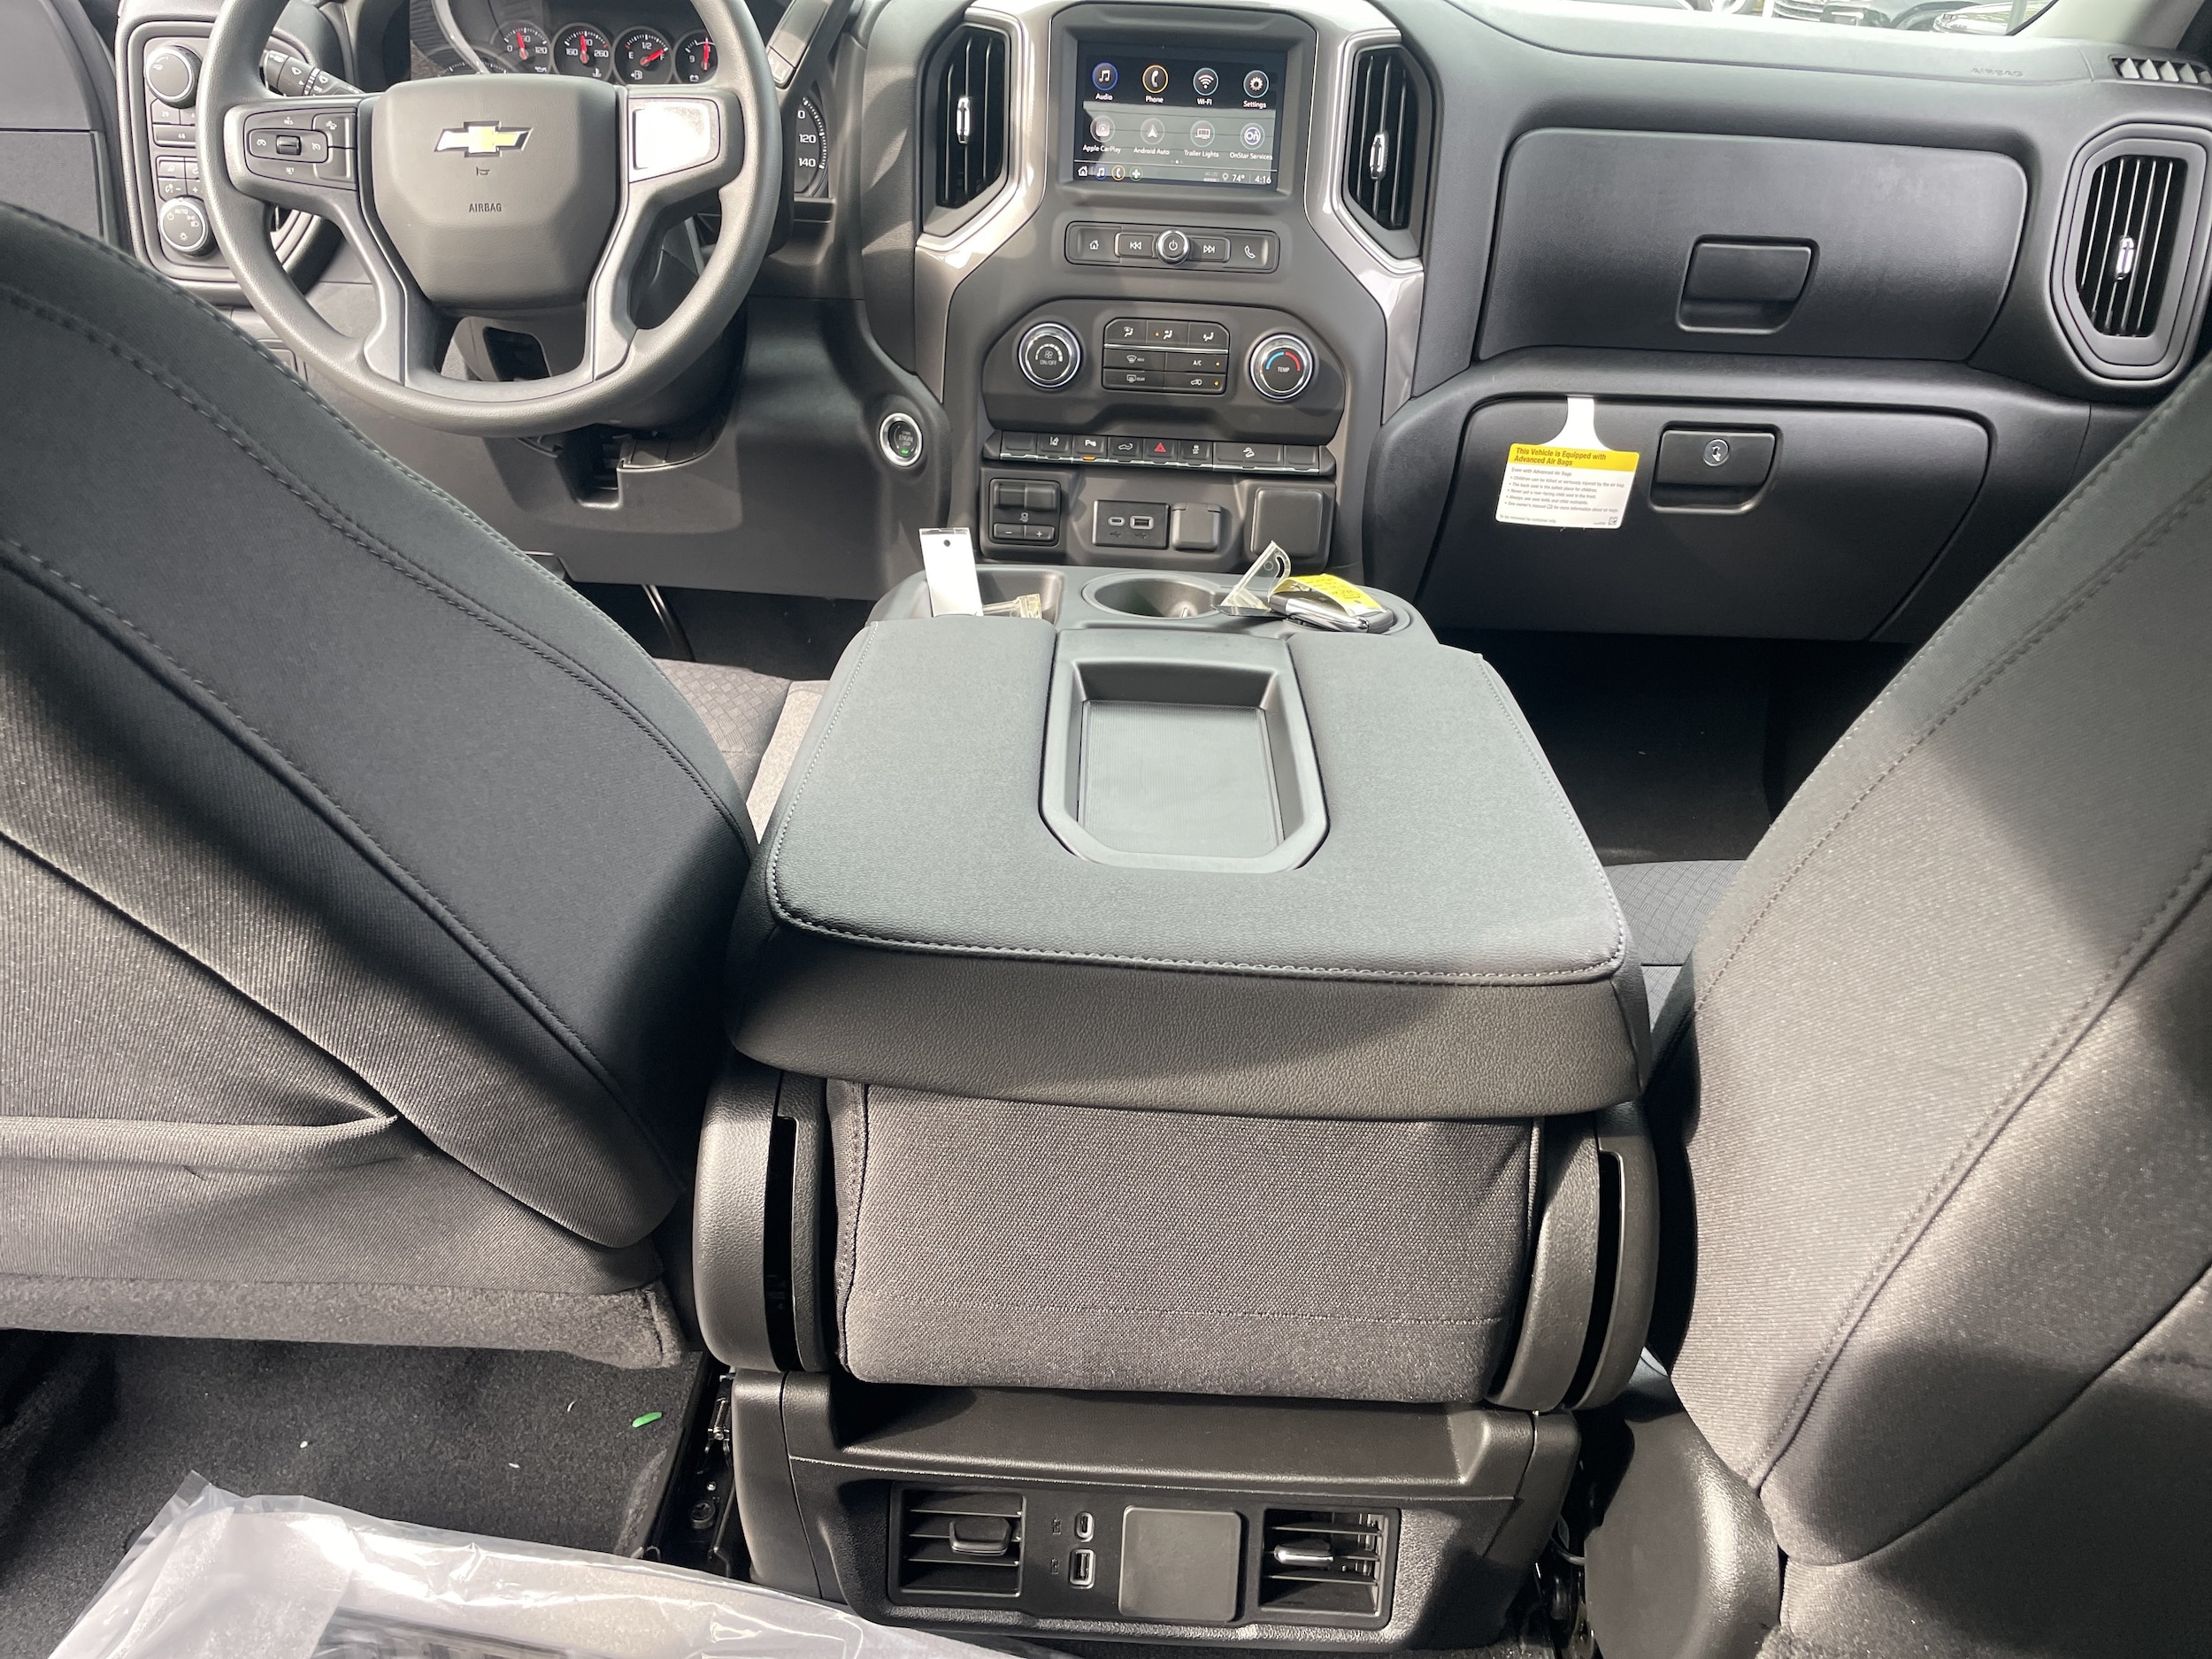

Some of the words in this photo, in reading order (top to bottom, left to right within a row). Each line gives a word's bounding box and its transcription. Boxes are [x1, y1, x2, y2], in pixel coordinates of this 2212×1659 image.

[535, 46, 548, 54] 120
[1243, 100, 1267, 108] Settings
[799, 134, 816, 143] 120
[1083, 145, 1100, 153] Apple
[1101, 145, 1121, 154] CarPlay
[1202, 150, 1219, 159] Lights
[799, 158, 816, 167] 140
[1255, 175, 1272, 184] 4:16
[469, 203, 502, 212] AIRBAG
[1514, 455, 1545, 464] Advanced
[1562, 451, 1591, 459] Equipped
